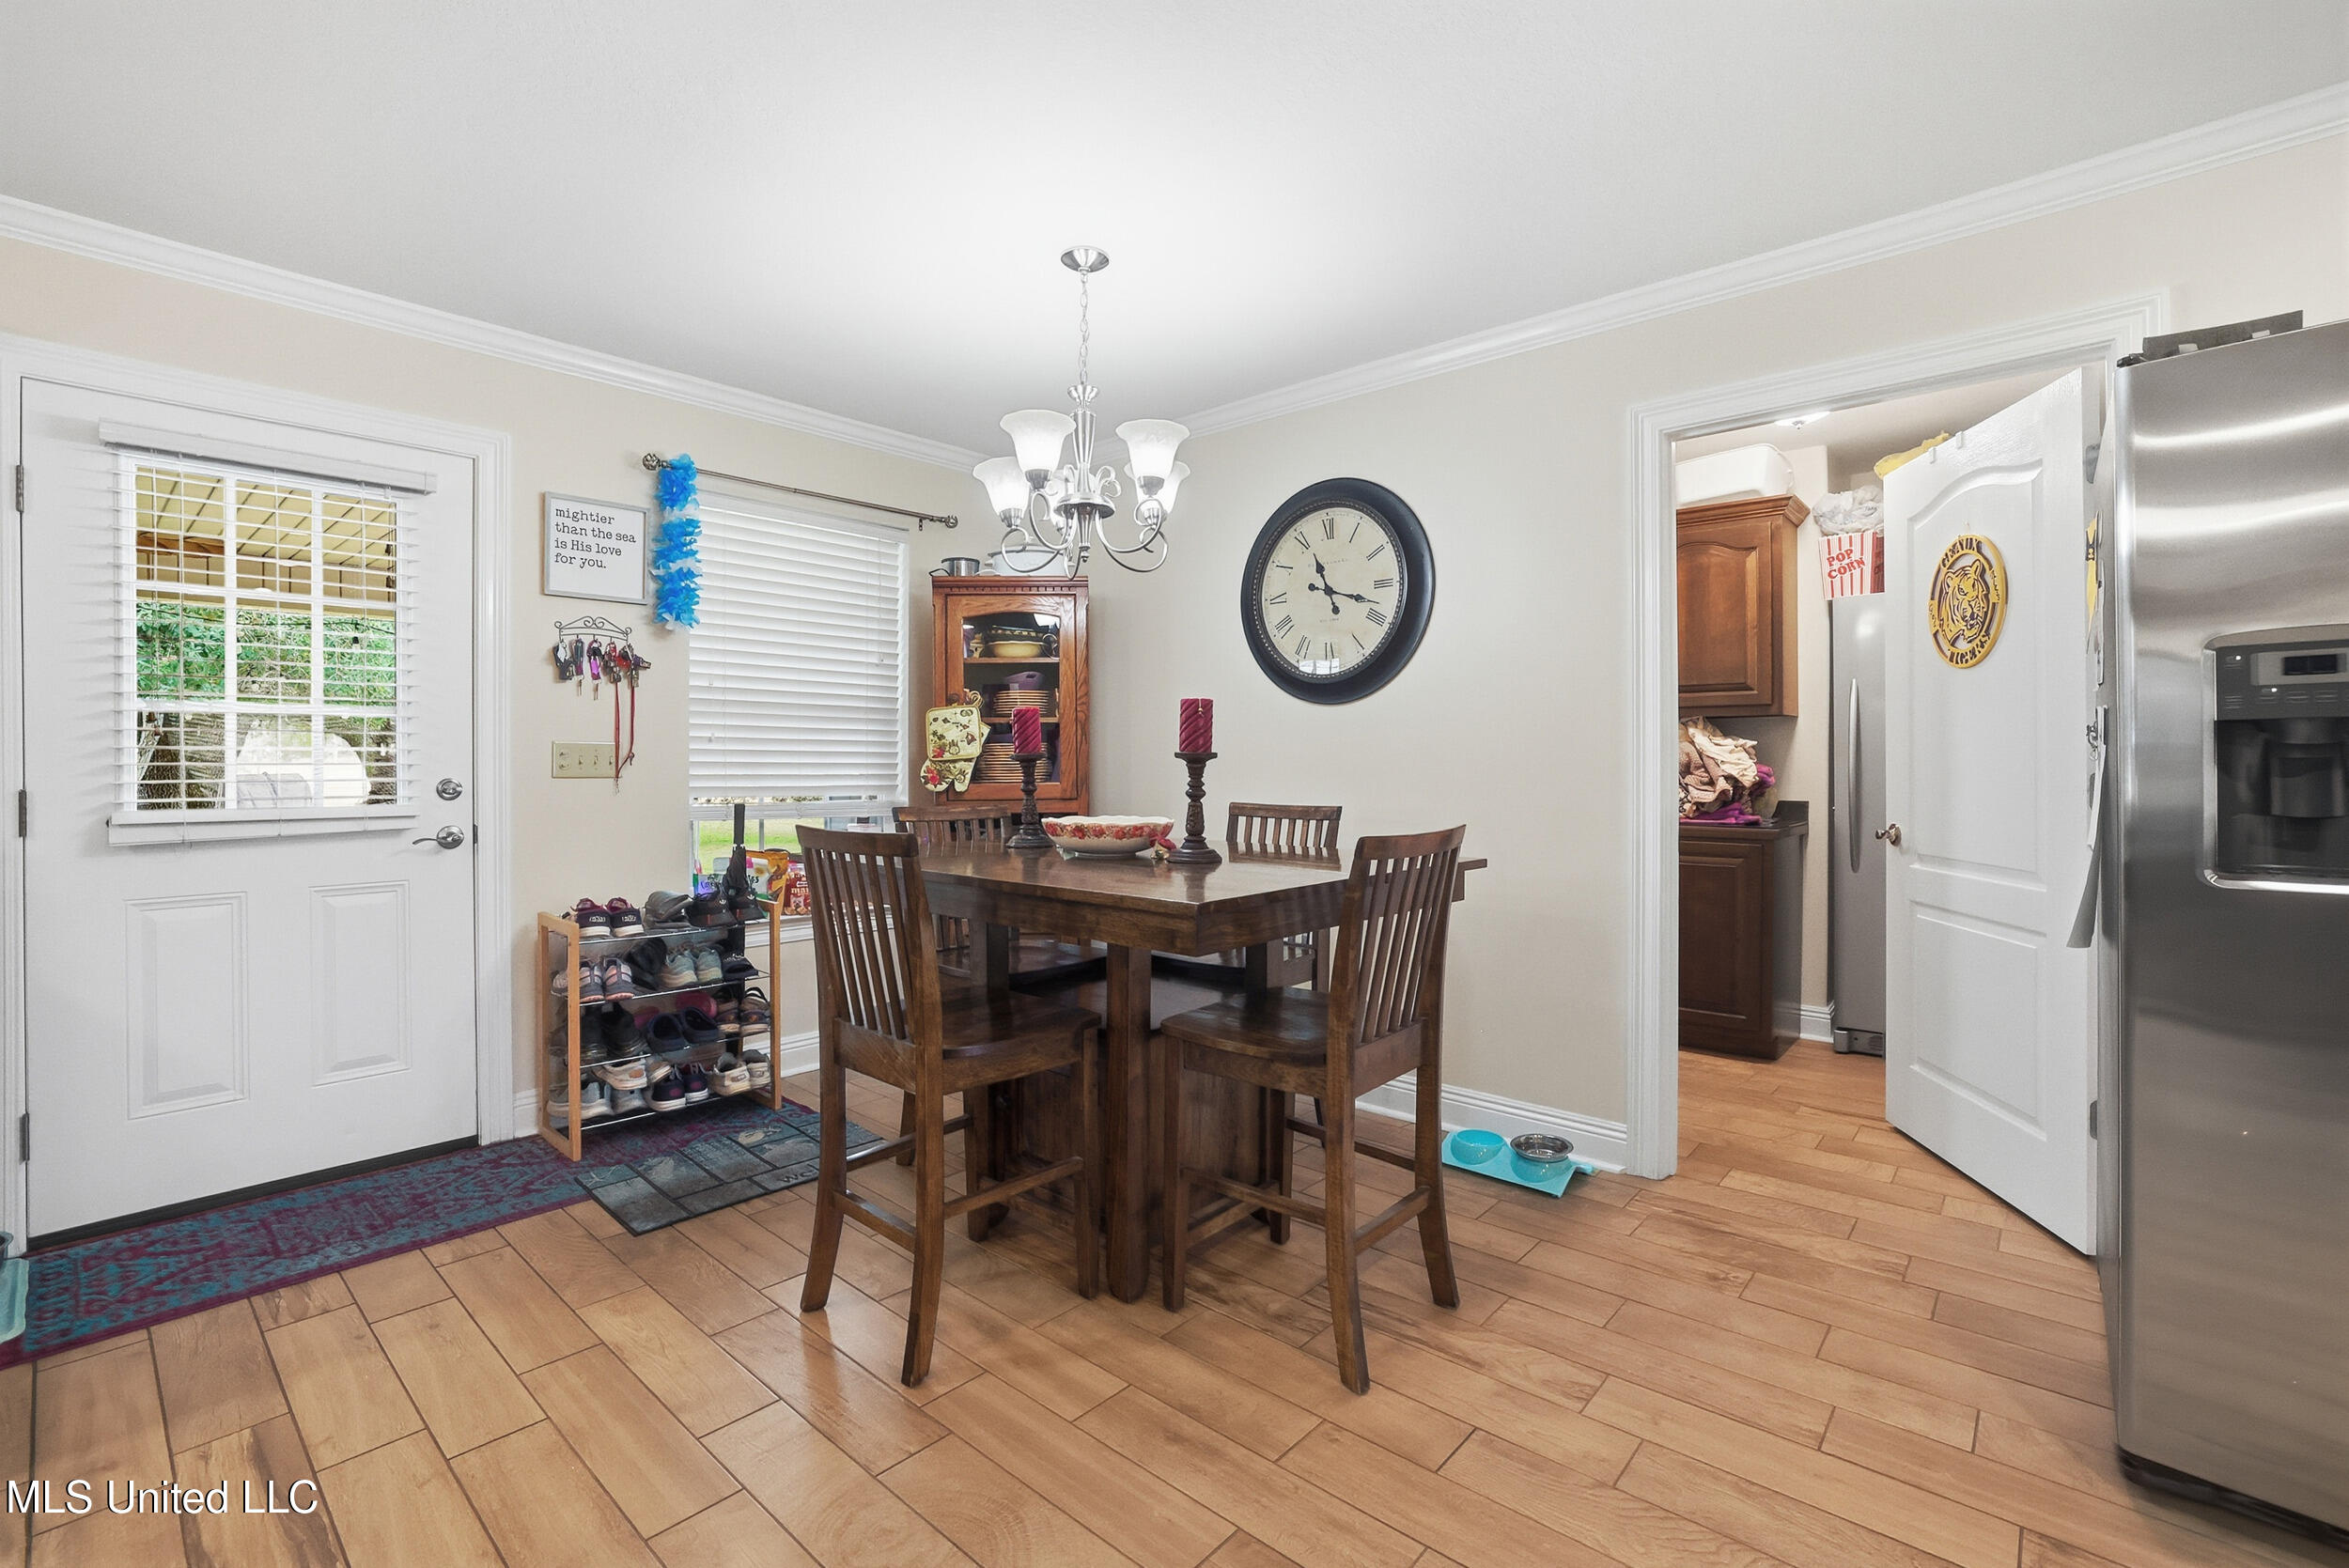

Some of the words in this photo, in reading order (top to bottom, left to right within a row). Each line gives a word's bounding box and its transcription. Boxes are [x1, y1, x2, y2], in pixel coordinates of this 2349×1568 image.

[555, 508, 614, 525] mightier
[555, 523, 587, 536] than
[591, 527, 613, 539] the
[615, 533, 636, 543] sea
[554, 537, 568, 550] is
[570, 540, 592, 552] His
[595, 544, 622, 556] love
[554, 552, 576, 565] for
[580, 558, 607, 569] you.
[1827, 548, 1854, 567] POP
[1828, 557, 1865, 579] CORN
